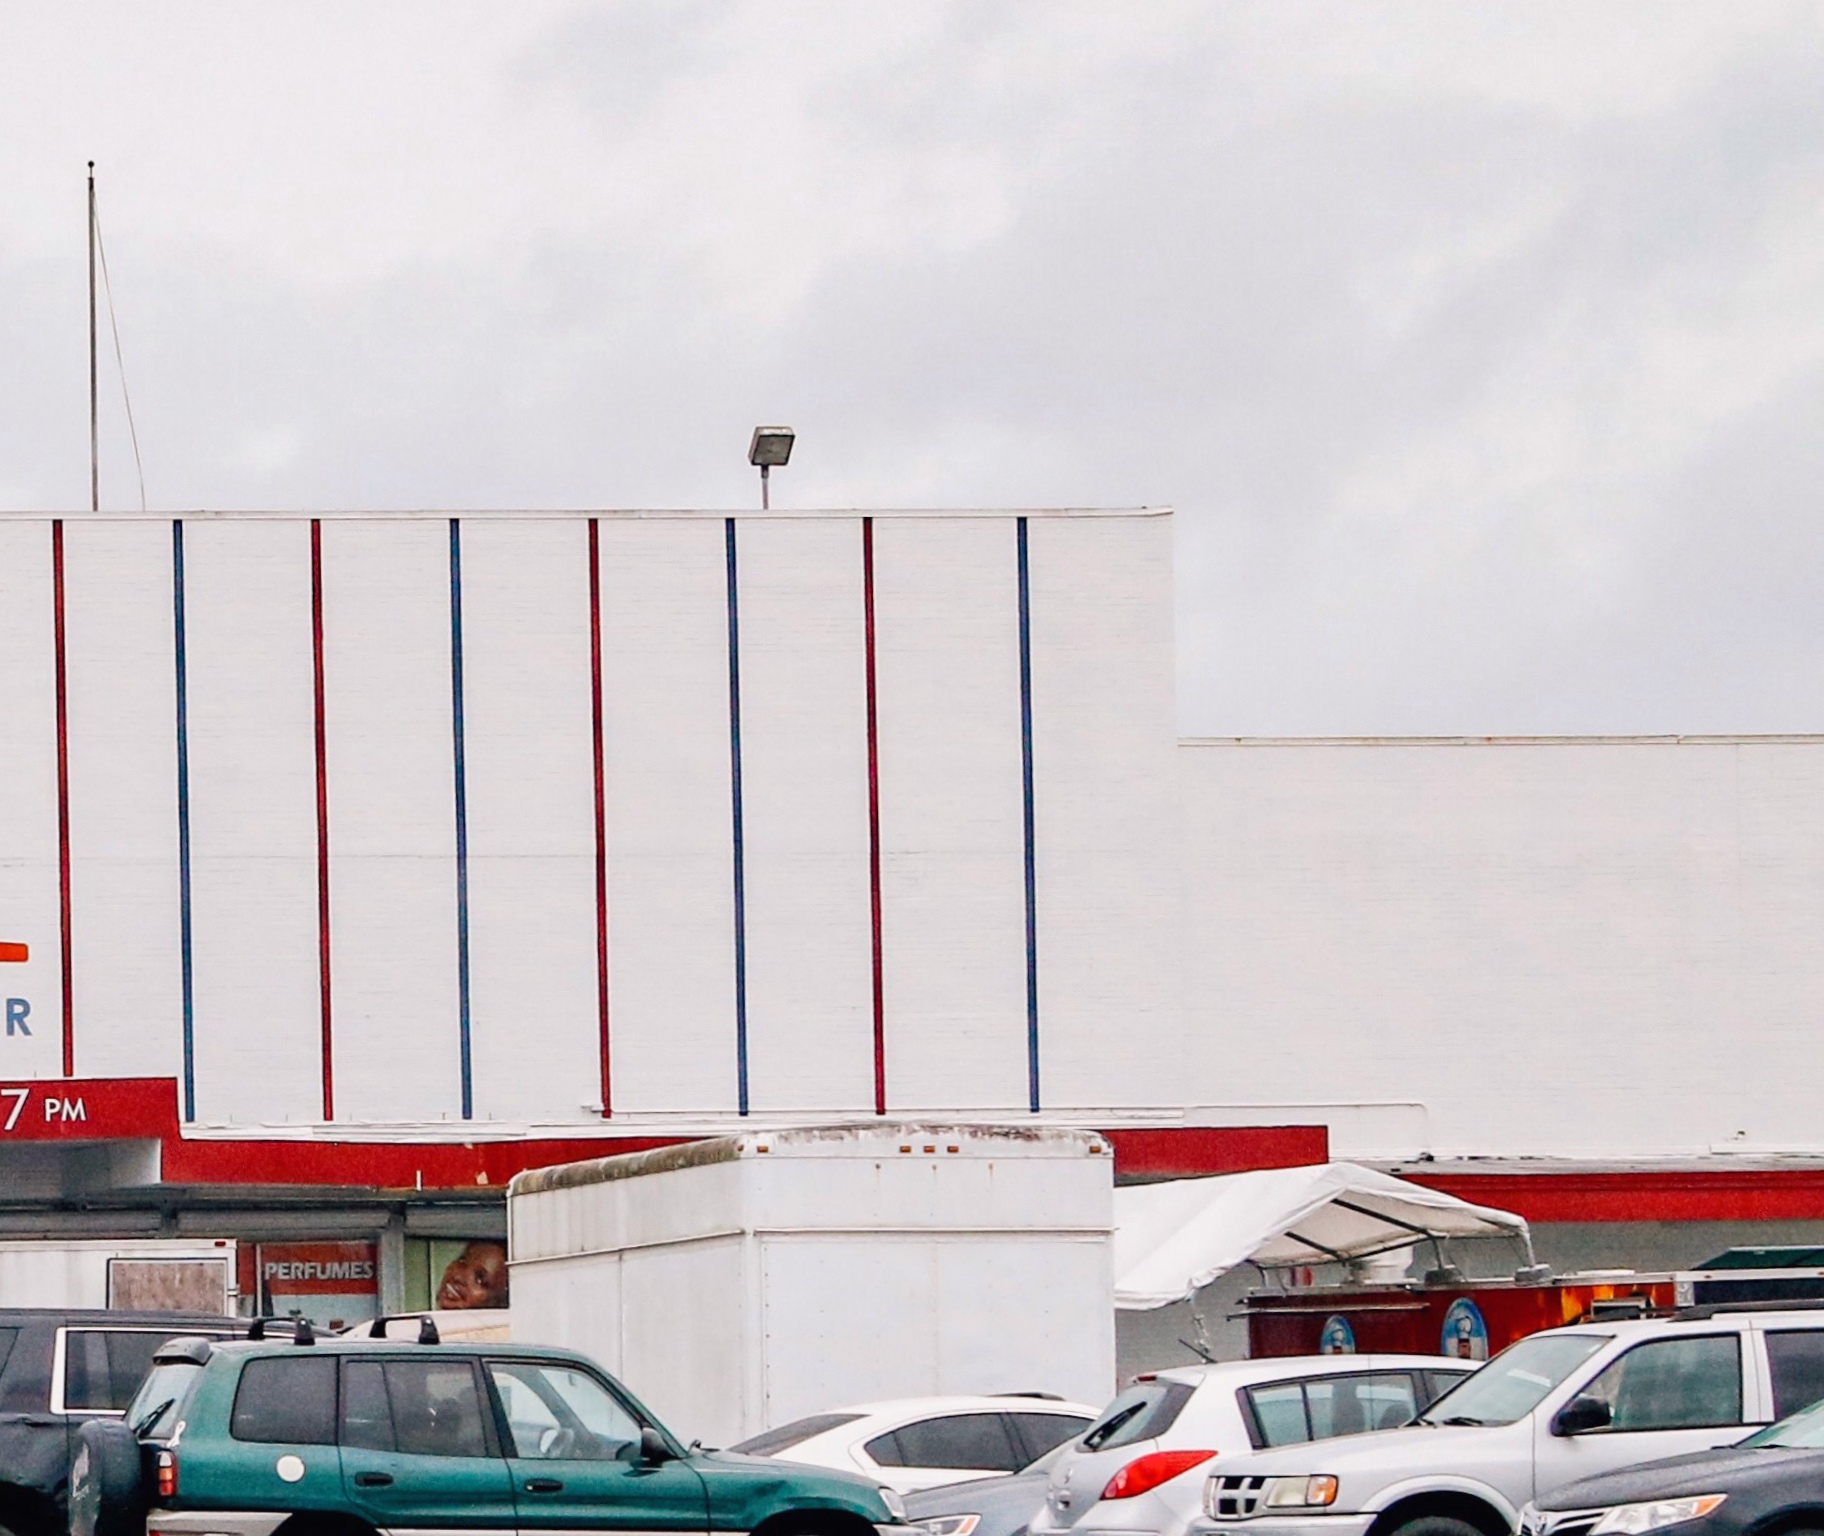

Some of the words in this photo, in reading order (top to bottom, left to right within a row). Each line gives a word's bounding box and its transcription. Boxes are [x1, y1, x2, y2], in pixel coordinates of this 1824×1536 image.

[0, 1088, 31, 1131] 7
[44, 1097, 87, 1123] PM
[264, 1260, 374, 1281] PERFUMES
